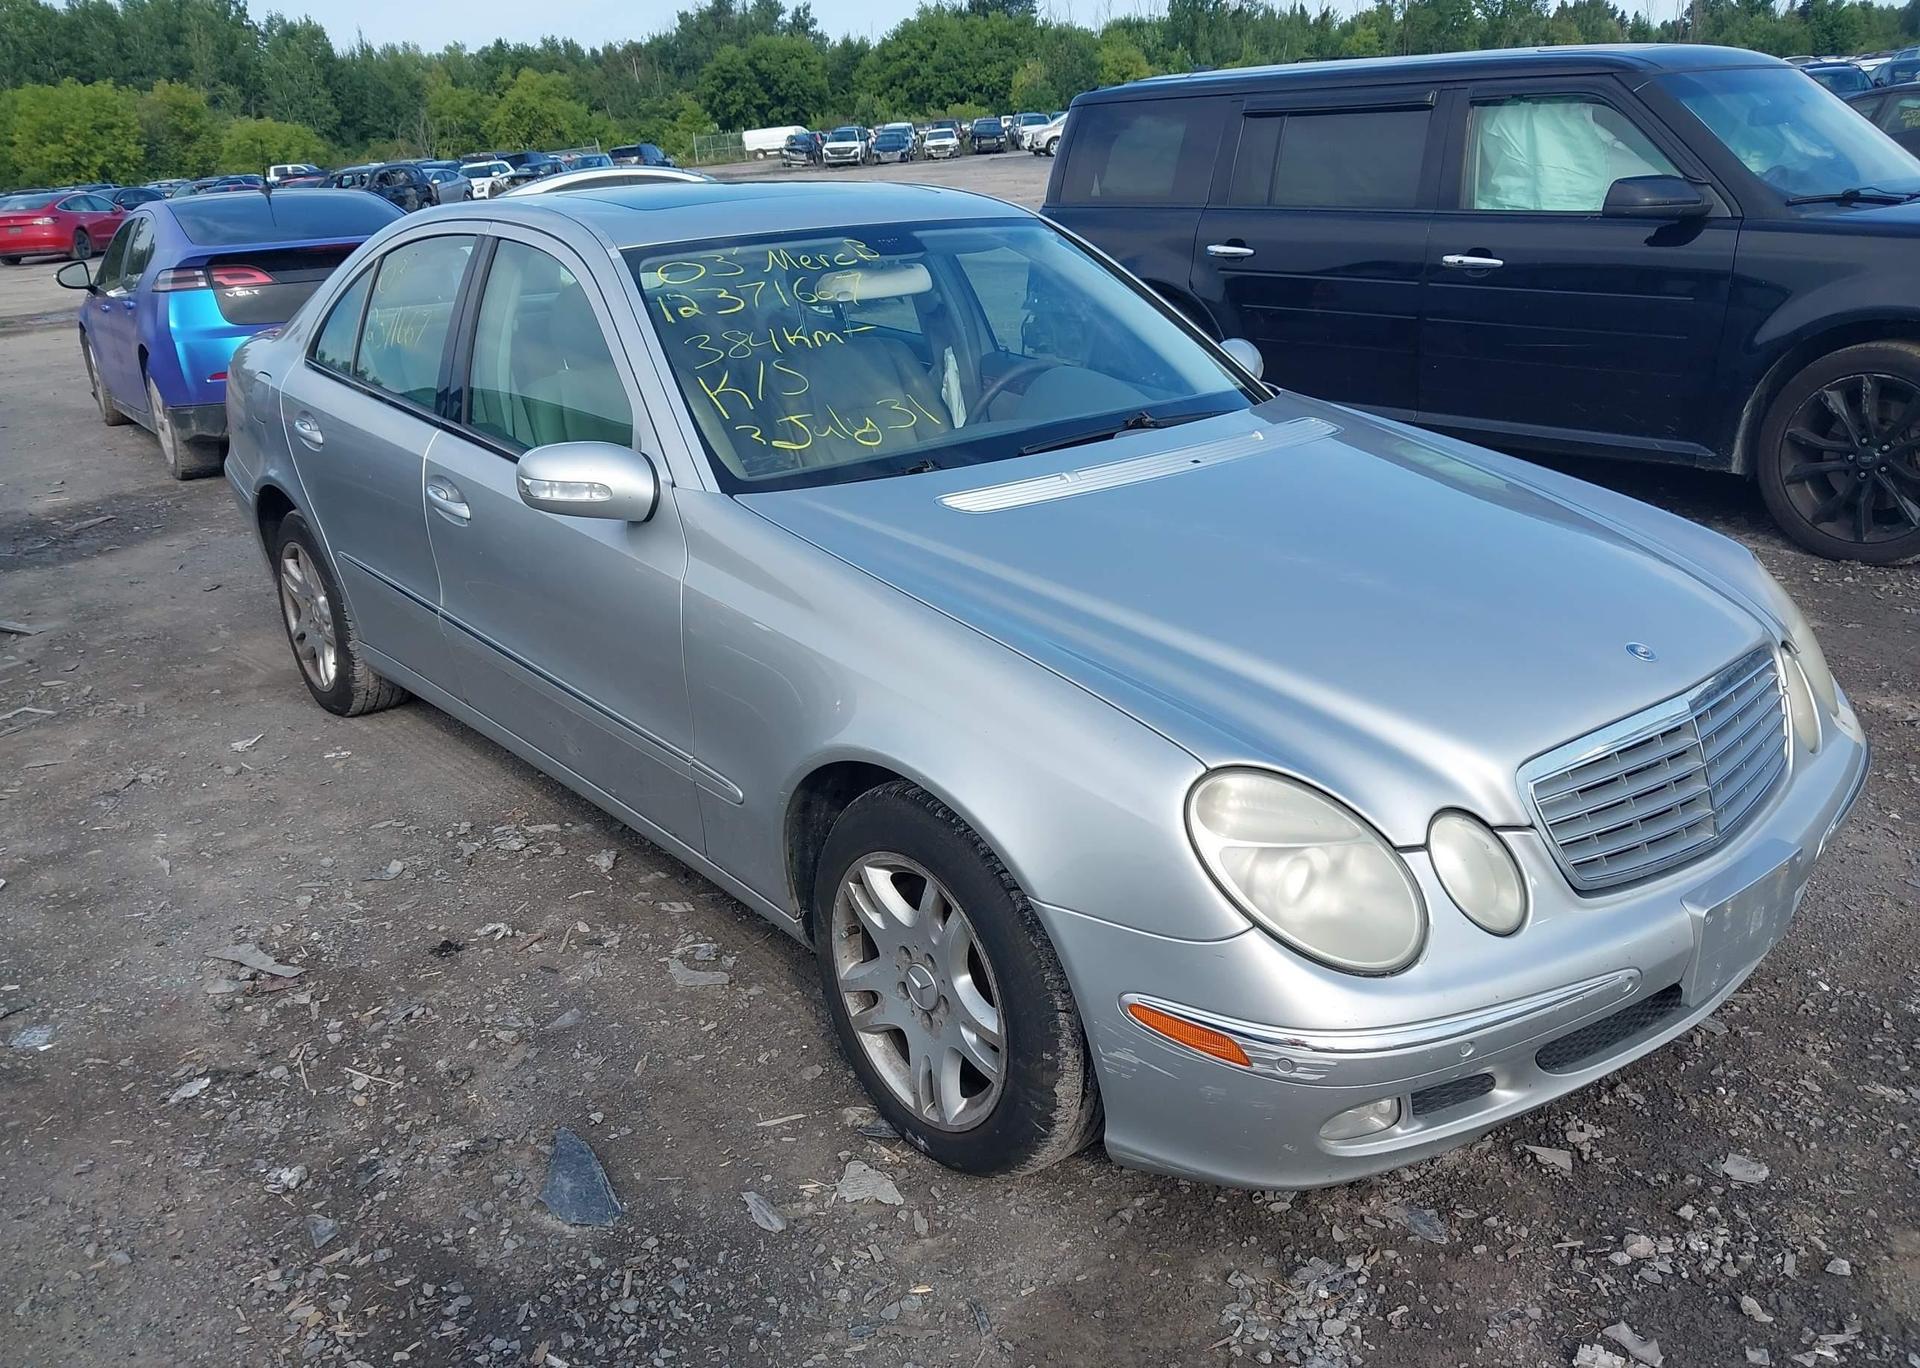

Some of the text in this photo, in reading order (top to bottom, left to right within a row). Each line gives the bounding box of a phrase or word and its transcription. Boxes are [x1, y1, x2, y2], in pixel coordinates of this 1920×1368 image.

[225, 289, 260, 297] VOLT
[656, 271, 862, 324] 12371667
[771, 404, 883, 450] July
[876, 393, 942, 430] 31
